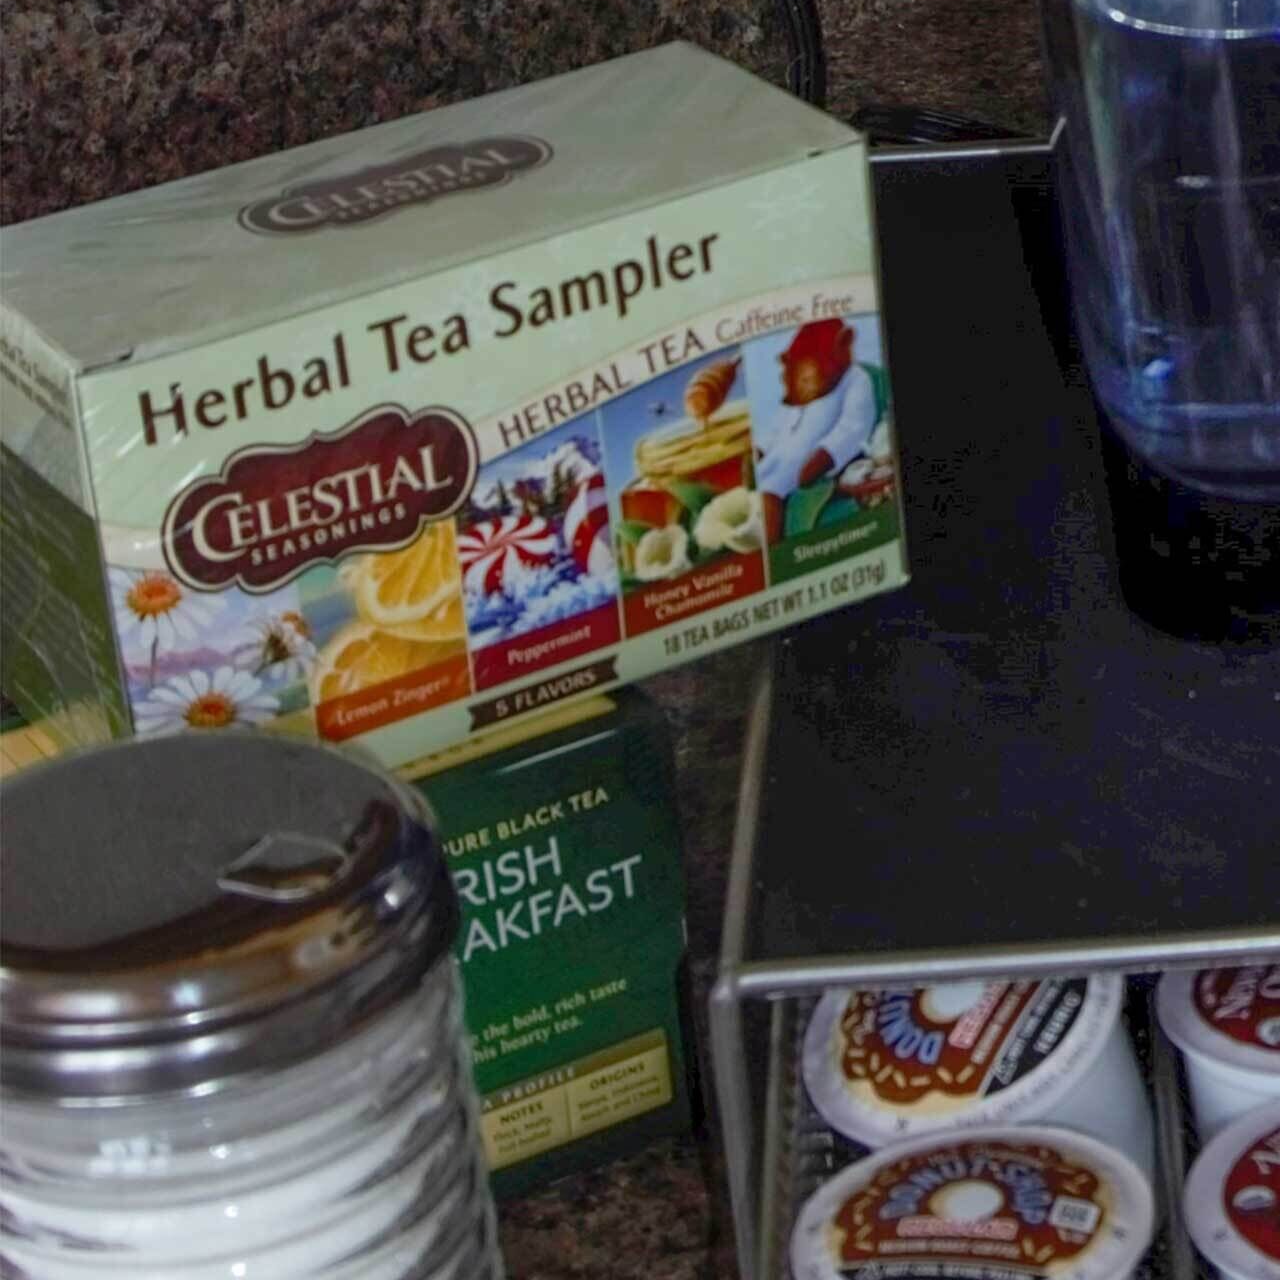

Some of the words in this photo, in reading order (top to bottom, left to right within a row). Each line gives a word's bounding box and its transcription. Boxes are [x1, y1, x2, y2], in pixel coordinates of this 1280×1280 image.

[139, 332, 352, 446] Herbal
[366, 314, 470, 373] Tea
[489, 232, 720, 339] Sampler
[498, 364, 634, 449] HERBAL
[638, 327, 706, 375] TEA
[714, 299, 803, 342] Caffeine
[810, 293, 855, 319] Free
[191, 445, 455, 563] CELESTIAL
[251, 503, 407, 566] SEASONINGS
[644, 582, 690, 609] Honey
[692, 564, 745, 591] Vanilla
[655, 583, 735, 621] Chamomile
[664, 633, 682, 656] 18
[684, 626, 709, 650] TEA
[712, 607, 750, 640] BAGS
[752, 598, 780, 627] NET
[782, 590, 804, 615] WT
[830, 575, 851, 596] OZ
[507, 625, 591, 667] Peppermint
[335, 698, 389, 727] Lemon
[495, 699, 509, 718] 5
[514, 668, 598, 710] FLAVORS
[443, 827, 491, 857] URE
[497, 801, 566, 841] BLACK
[568, 786, 610, 813] TEA
[457, 854, 642, 963] AKFAST
[482, 1023, 509, 1042] the
[555, 992, 587, 1014] rich
[590, 978, 628, 1000] taste
[501, 1024, 551, 1055] hearty
[502, 1065, 575, 1103] PROFILE
[589, 1062, 646, 1090] ORIGINS
[501, 1101, 544, 1124] NOTES
